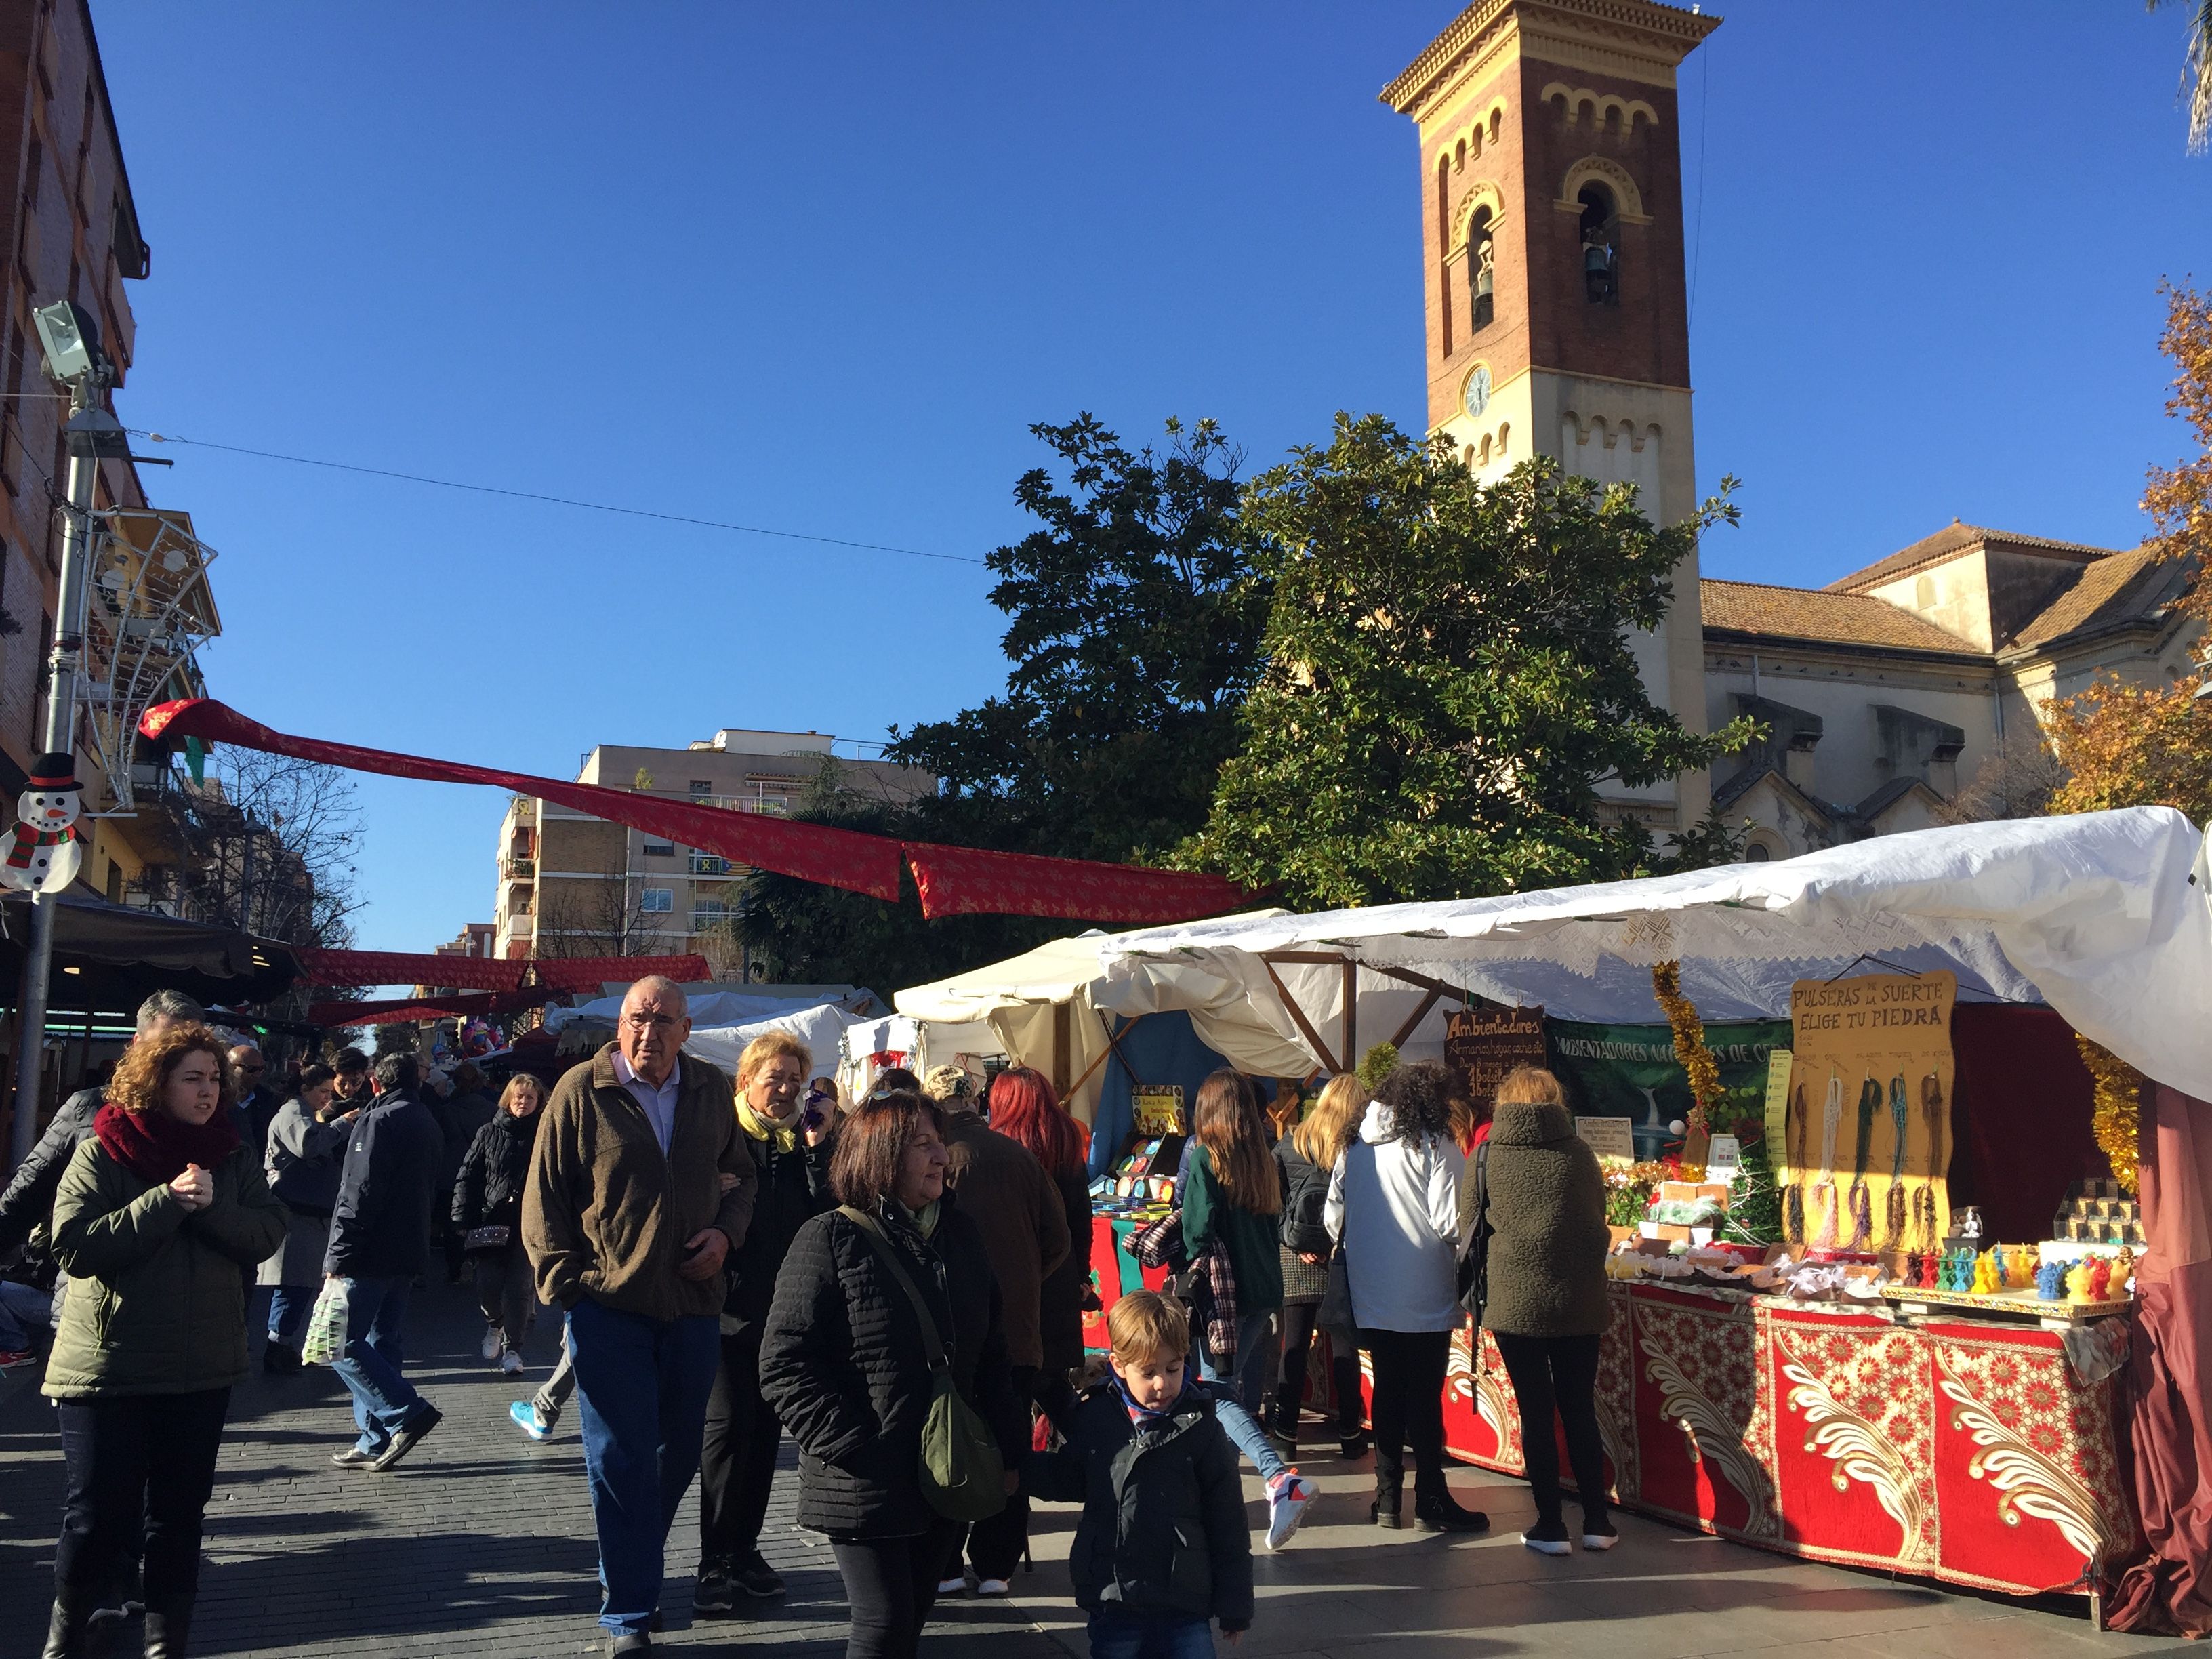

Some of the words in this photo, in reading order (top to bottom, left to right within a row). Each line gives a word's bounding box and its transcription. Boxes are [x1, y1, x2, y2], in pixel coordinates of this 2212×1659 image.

[1793, 987, 1861, 1010] PULSERAS
[1866, 996, 1877, 1006] LA
[1881, 983, 1942, 1004] SUERTE
[1446, 1012, 1540, 1042] Ambientadores
[1800, 1012, 1841, 1031] ELIGE
[1847, 1011, 1866, 1029] TU
[1871, 1005, 1942, 1027] PIEDRA
[1477, 1057, 1482, 1069] 8
[1729, 1044, 1753, 1063] DE
[1468, 1066, 1475, 1082] 1
[1469, 1082, 1476, 1097] 3
